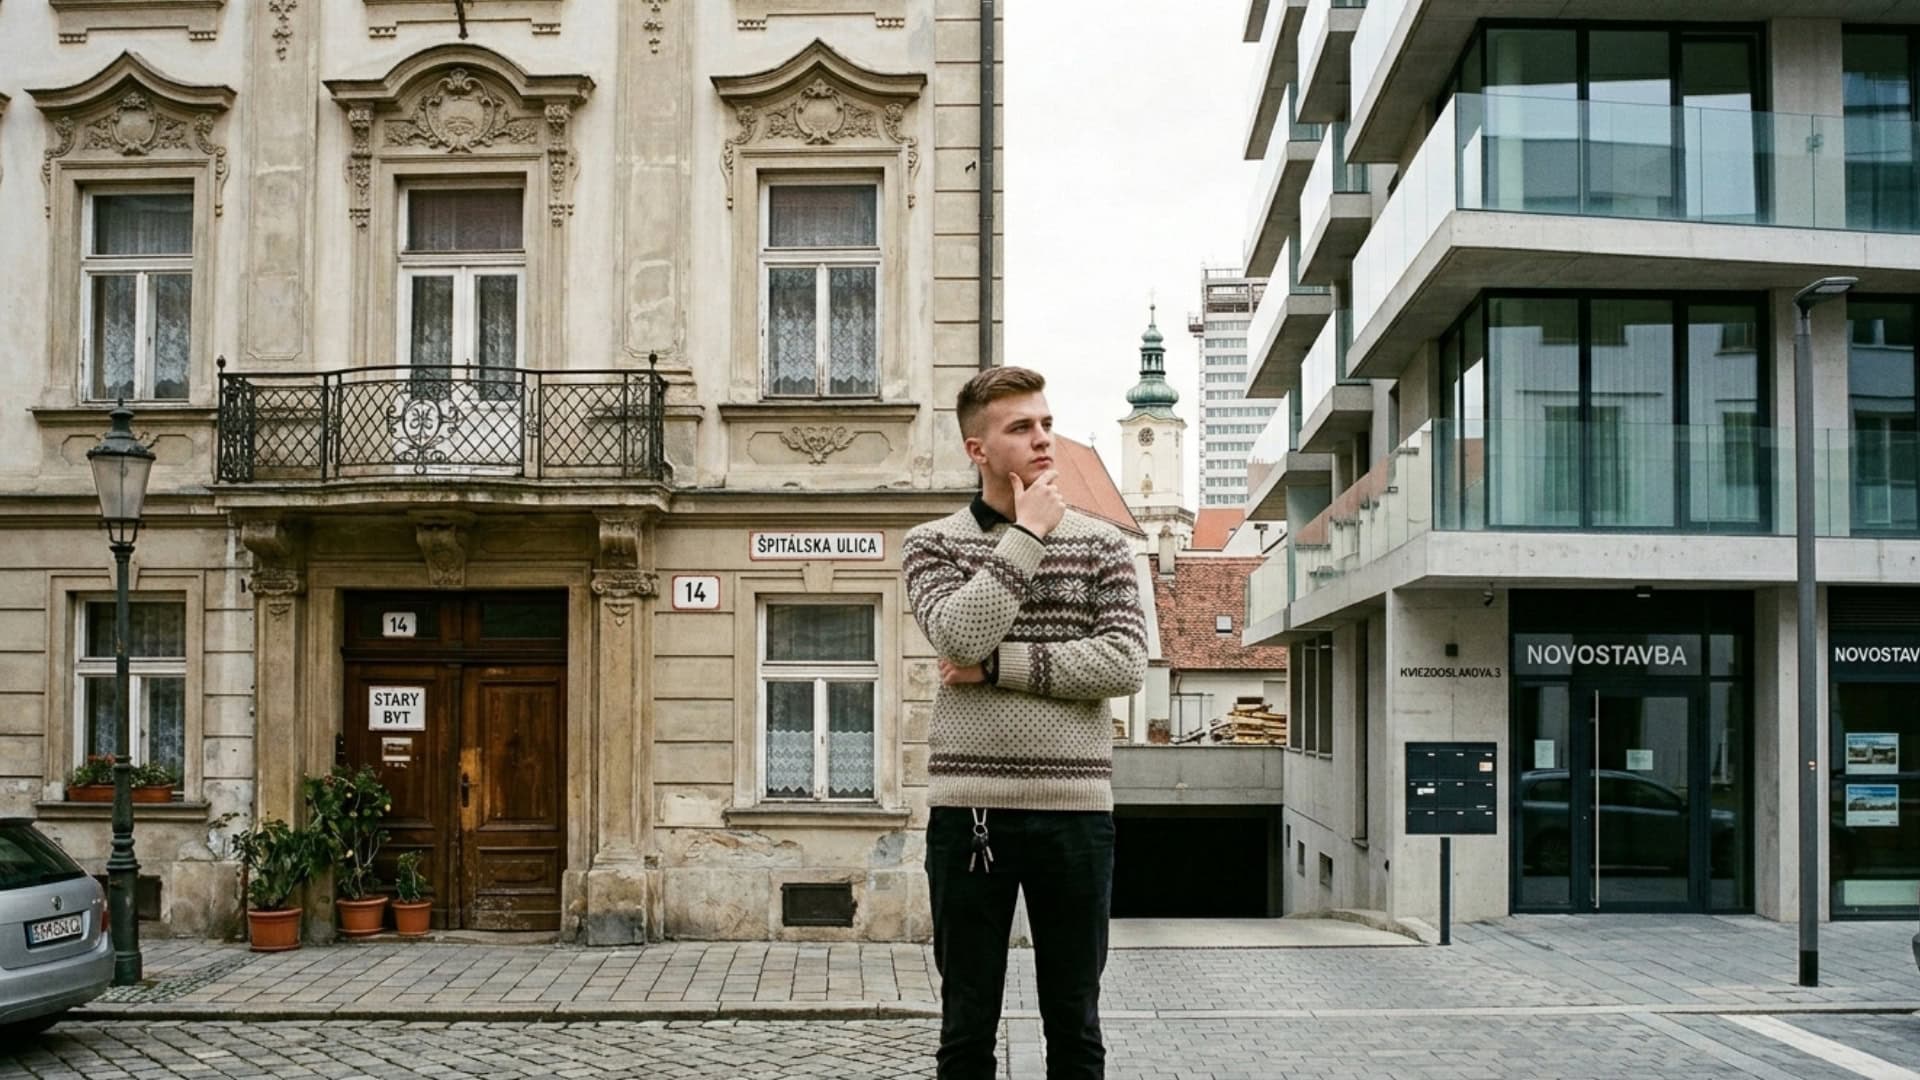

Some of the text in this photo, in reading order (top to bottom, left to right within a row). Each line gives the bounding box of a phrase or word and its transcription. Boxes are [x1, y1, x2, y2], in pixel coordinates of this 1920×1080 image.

[837, 538, 877, 553] ULICA
[685, 581, 706, 602] 14
[390, 616, 407, 633] 14
[1527, 644, 1687, 666] NOVOSTAVBA
[1834, 646, 1920, 662] NOVOSTAV
[374, 692, 419, 706] STARY
[383, 711, 410, 724] BYT
